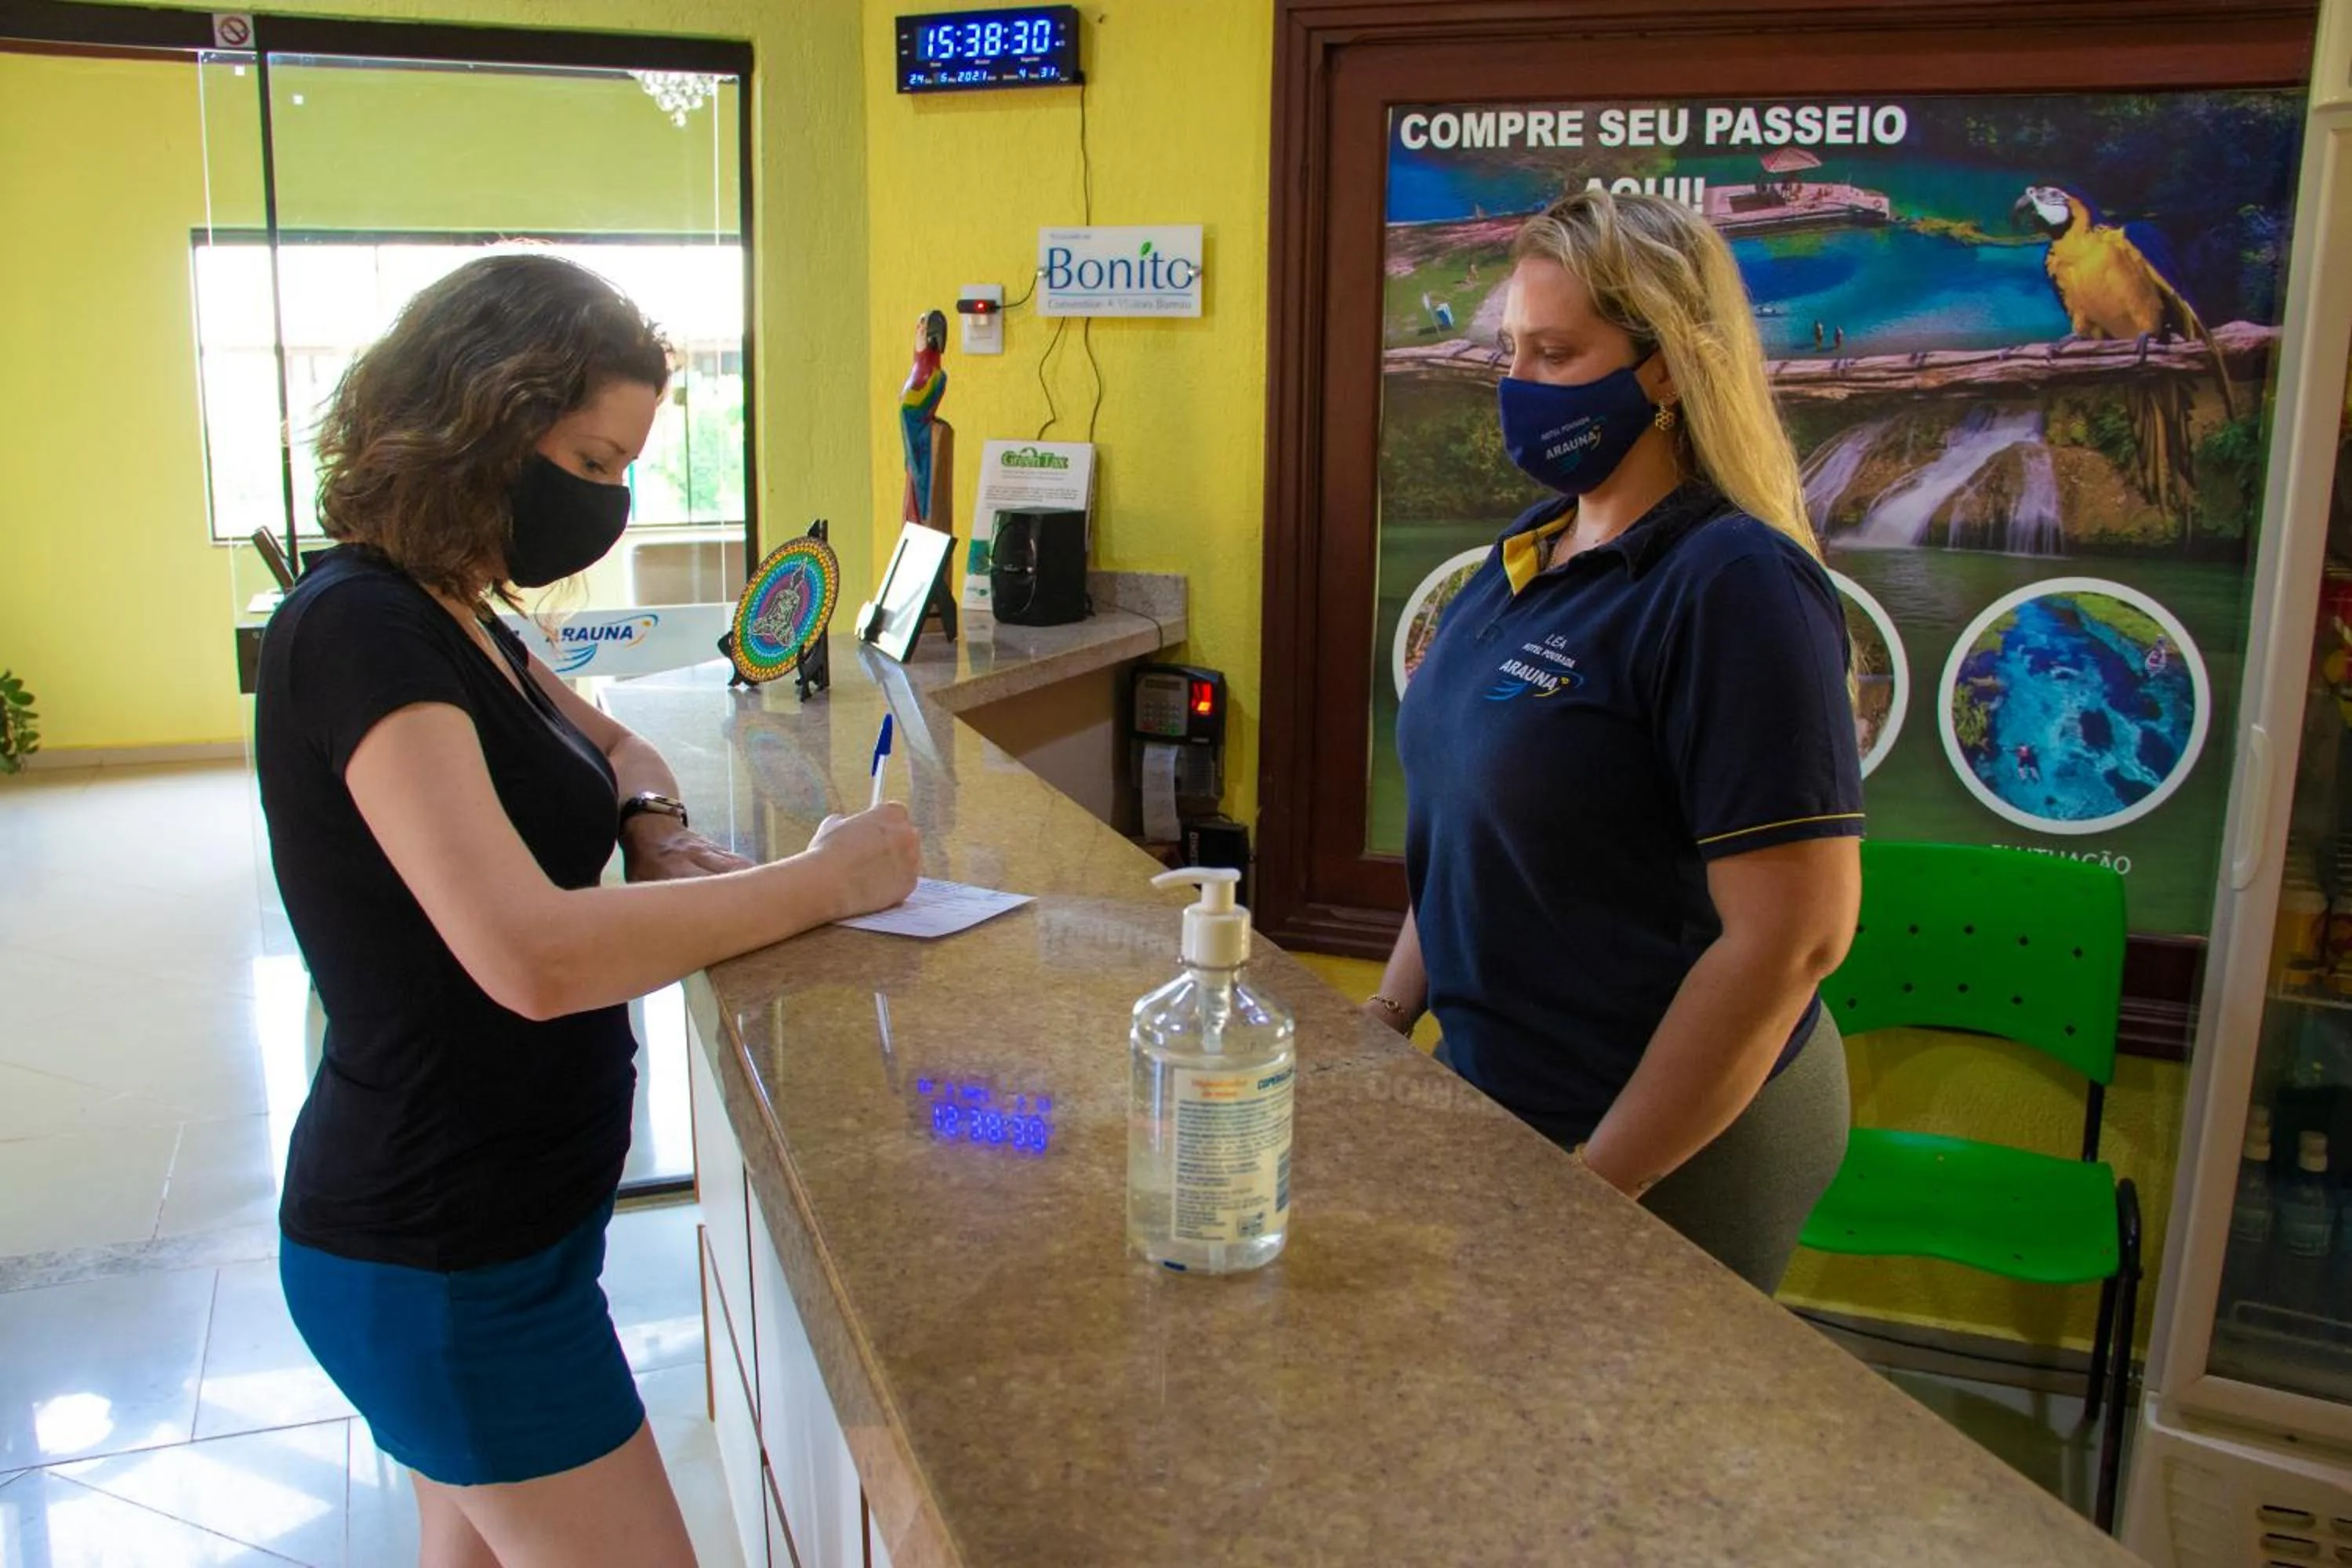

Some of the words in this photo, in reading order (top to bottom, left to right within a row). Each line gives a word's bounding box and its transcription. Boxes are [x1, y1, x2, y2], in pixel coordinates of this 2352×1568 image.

[927, 19, 1051, 59] 15:38:30
[909, 74, 924, 85] 24
[957, 70, 987, 82] 2021
[1399, 109, 1584, 149] COMPRE
[1598, 108, 1690, 147] SEU
[1704, 105, 1907, 145] PASSEIO
[1047, 241, 1193, 289] Bonito
[1545, 431, 1597, 460] ARAUNA
[1498, 659, 1559, 691] ARAUNA
